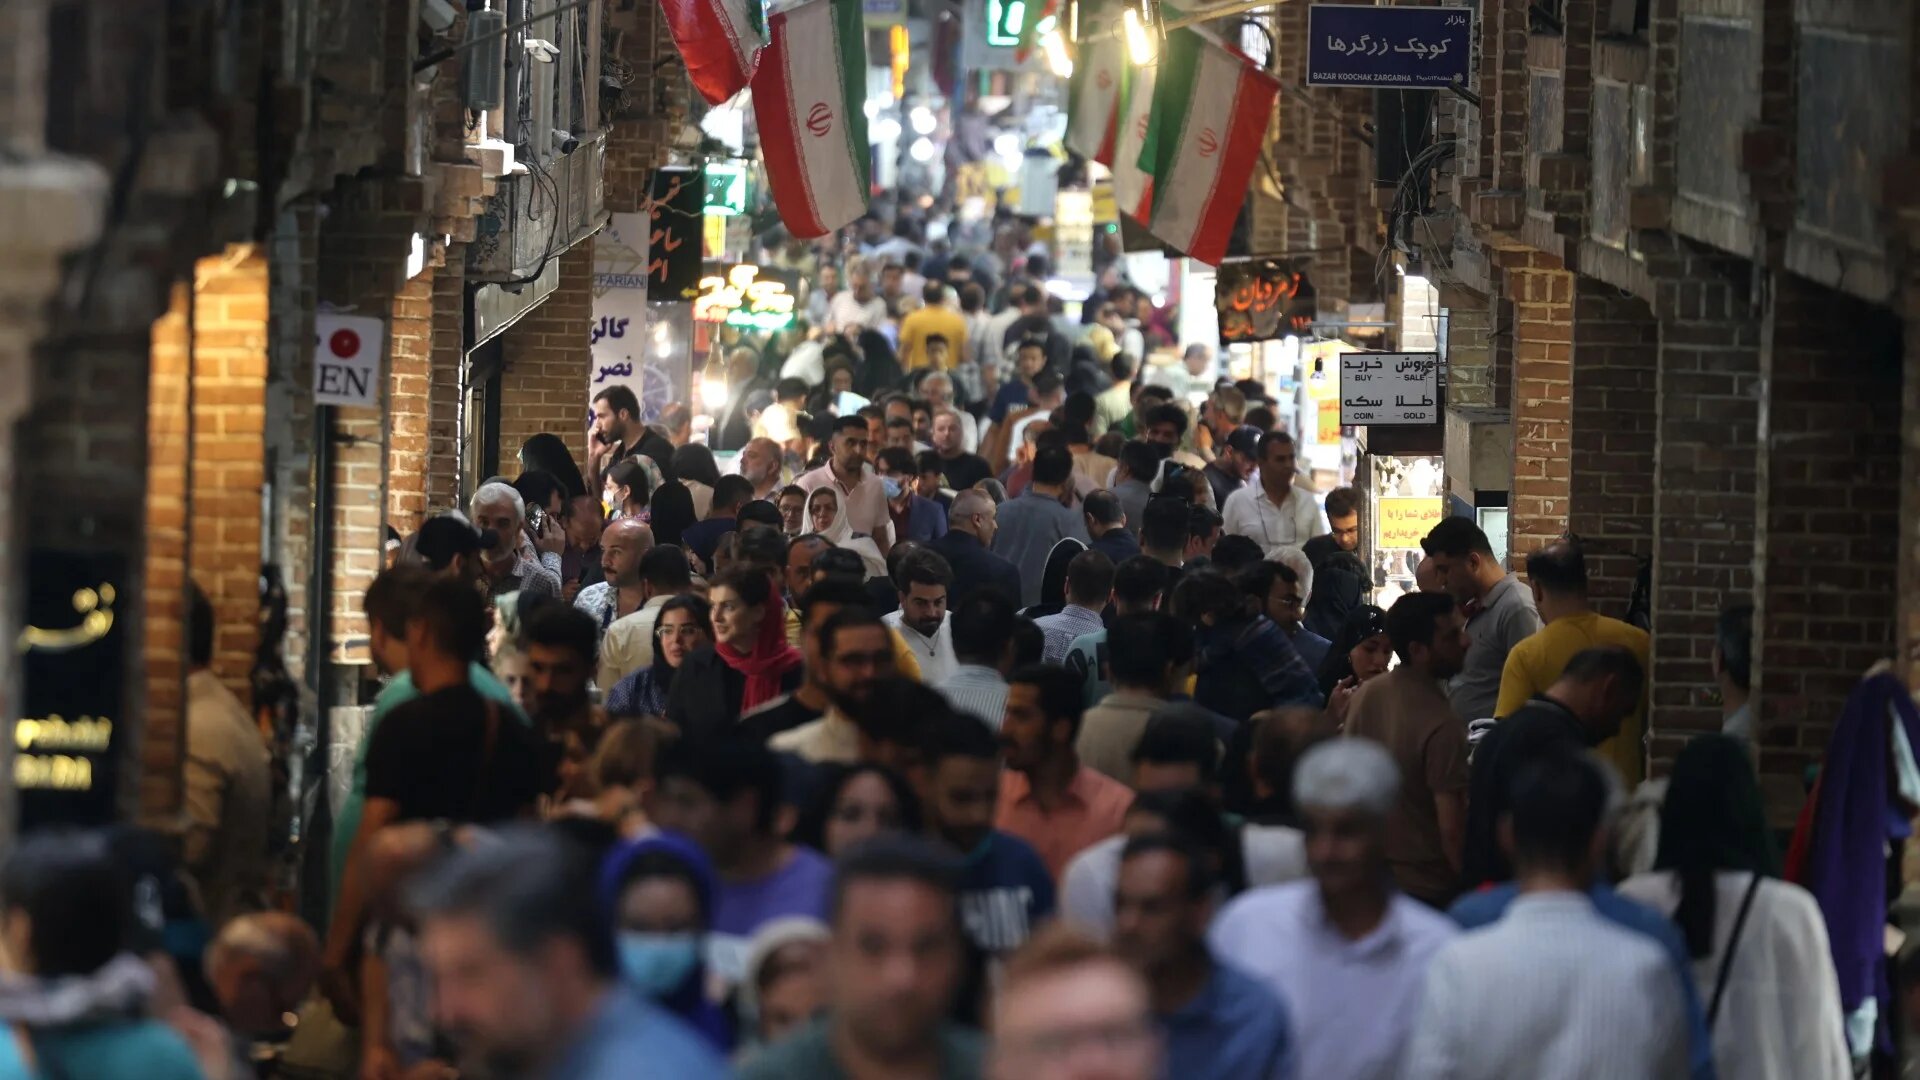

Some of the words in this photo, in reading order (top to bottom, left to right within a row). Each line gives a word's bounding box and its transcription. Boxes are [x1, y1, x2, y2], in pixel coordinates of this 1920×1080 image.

[1445, 15, 1465, 25] بازار
[1327, 35, 1388, 56] زرگرها
[1394, 38, 1451, 59] کوچک
[1313, 72, 1337, 80] BAZAR
[1338, 73, 1372, 81] KOOCHAK
[1373, 74, 1412, 82] ZARGARHA
[1344, 357, 1382, 372] خرید
[1345, 396, 1382, 407] سکه
[1395, 395, 1433, 407] طلا
